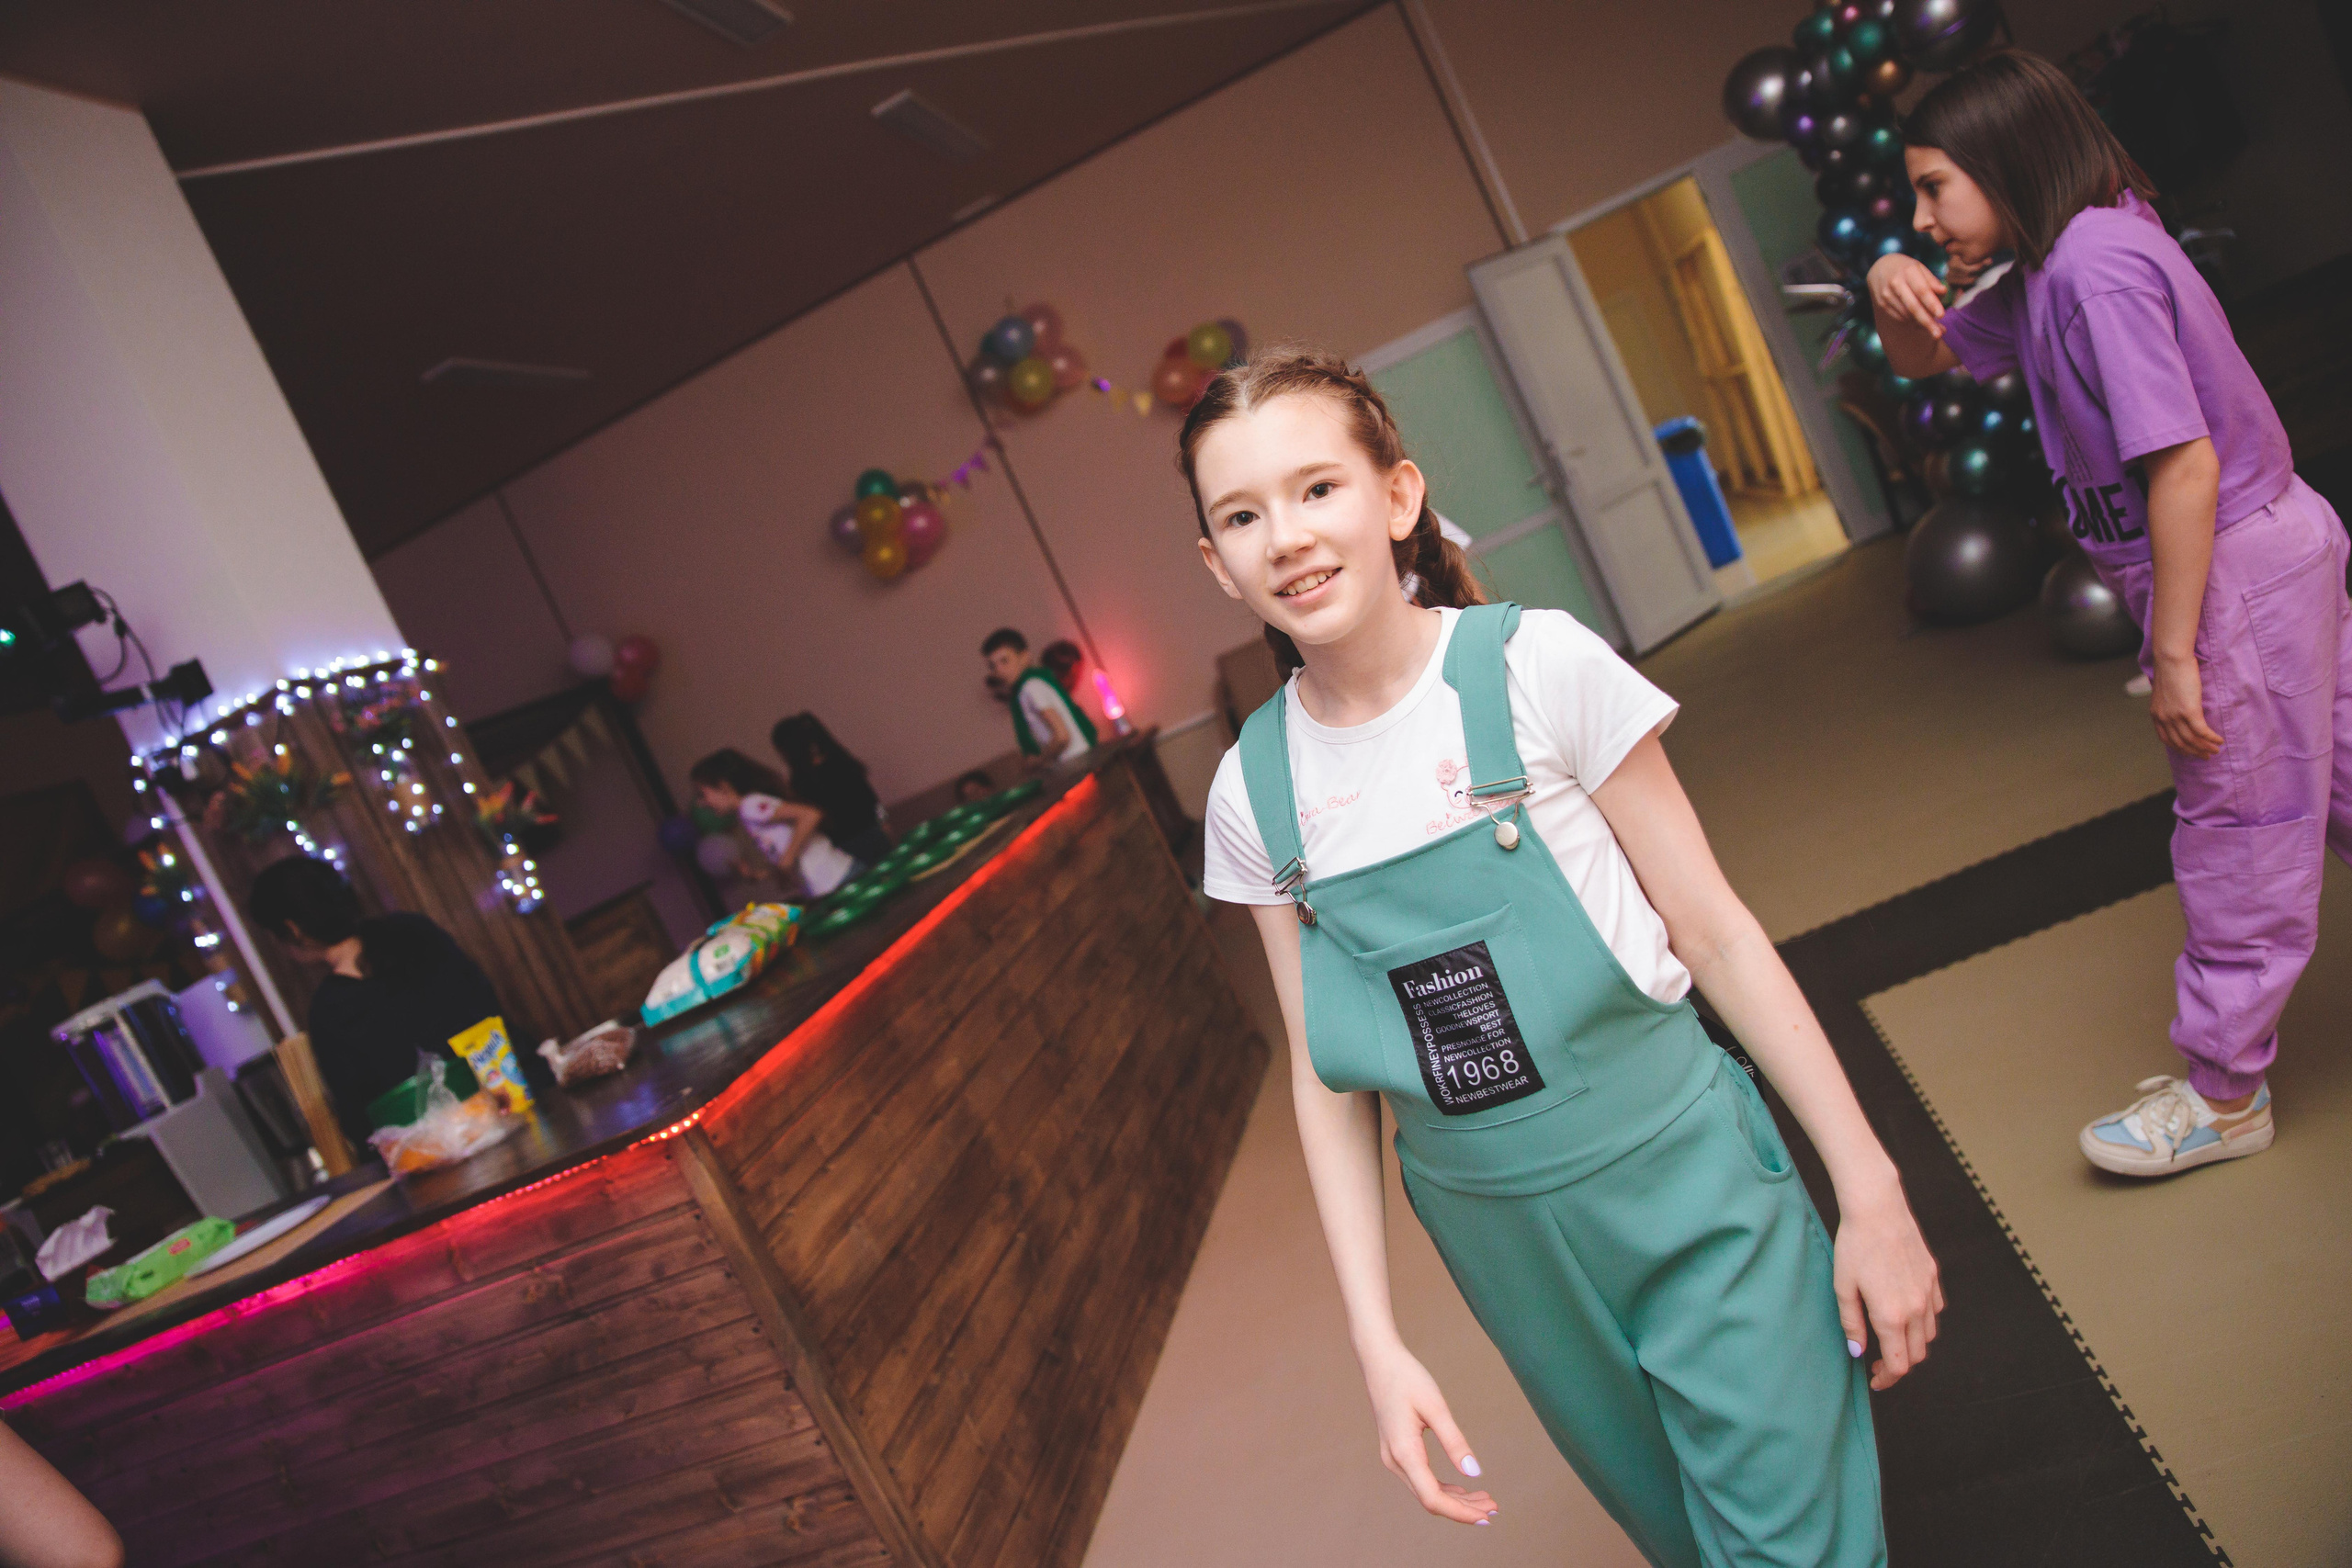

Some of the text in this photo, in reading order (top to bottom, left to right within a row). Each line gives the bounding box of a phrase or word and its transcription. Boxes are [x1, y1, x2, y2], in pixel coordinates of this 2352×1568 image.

[1402, 965, 1484, 998] Fashion
[1423, 982, 1489, 1008] NEWCOLLECTION
[1428, 991, 1494, 1017] CLASSICFASHION
[1435, 1010, 1499, 1034] GOODNEWSPORT
[1453, 1001, 1496, 1020] THELOVES
[1480, 1019, 1502, 1032] BEST
[1487, 1029, 1506, 1040] FOR
[1444, 1037, 1511, 1063] NEWCOLLECTION
[1446, 1050, 1520, 1089] 1968
[1455, 1076, 1530, 1105] NEWBESTWEAR
